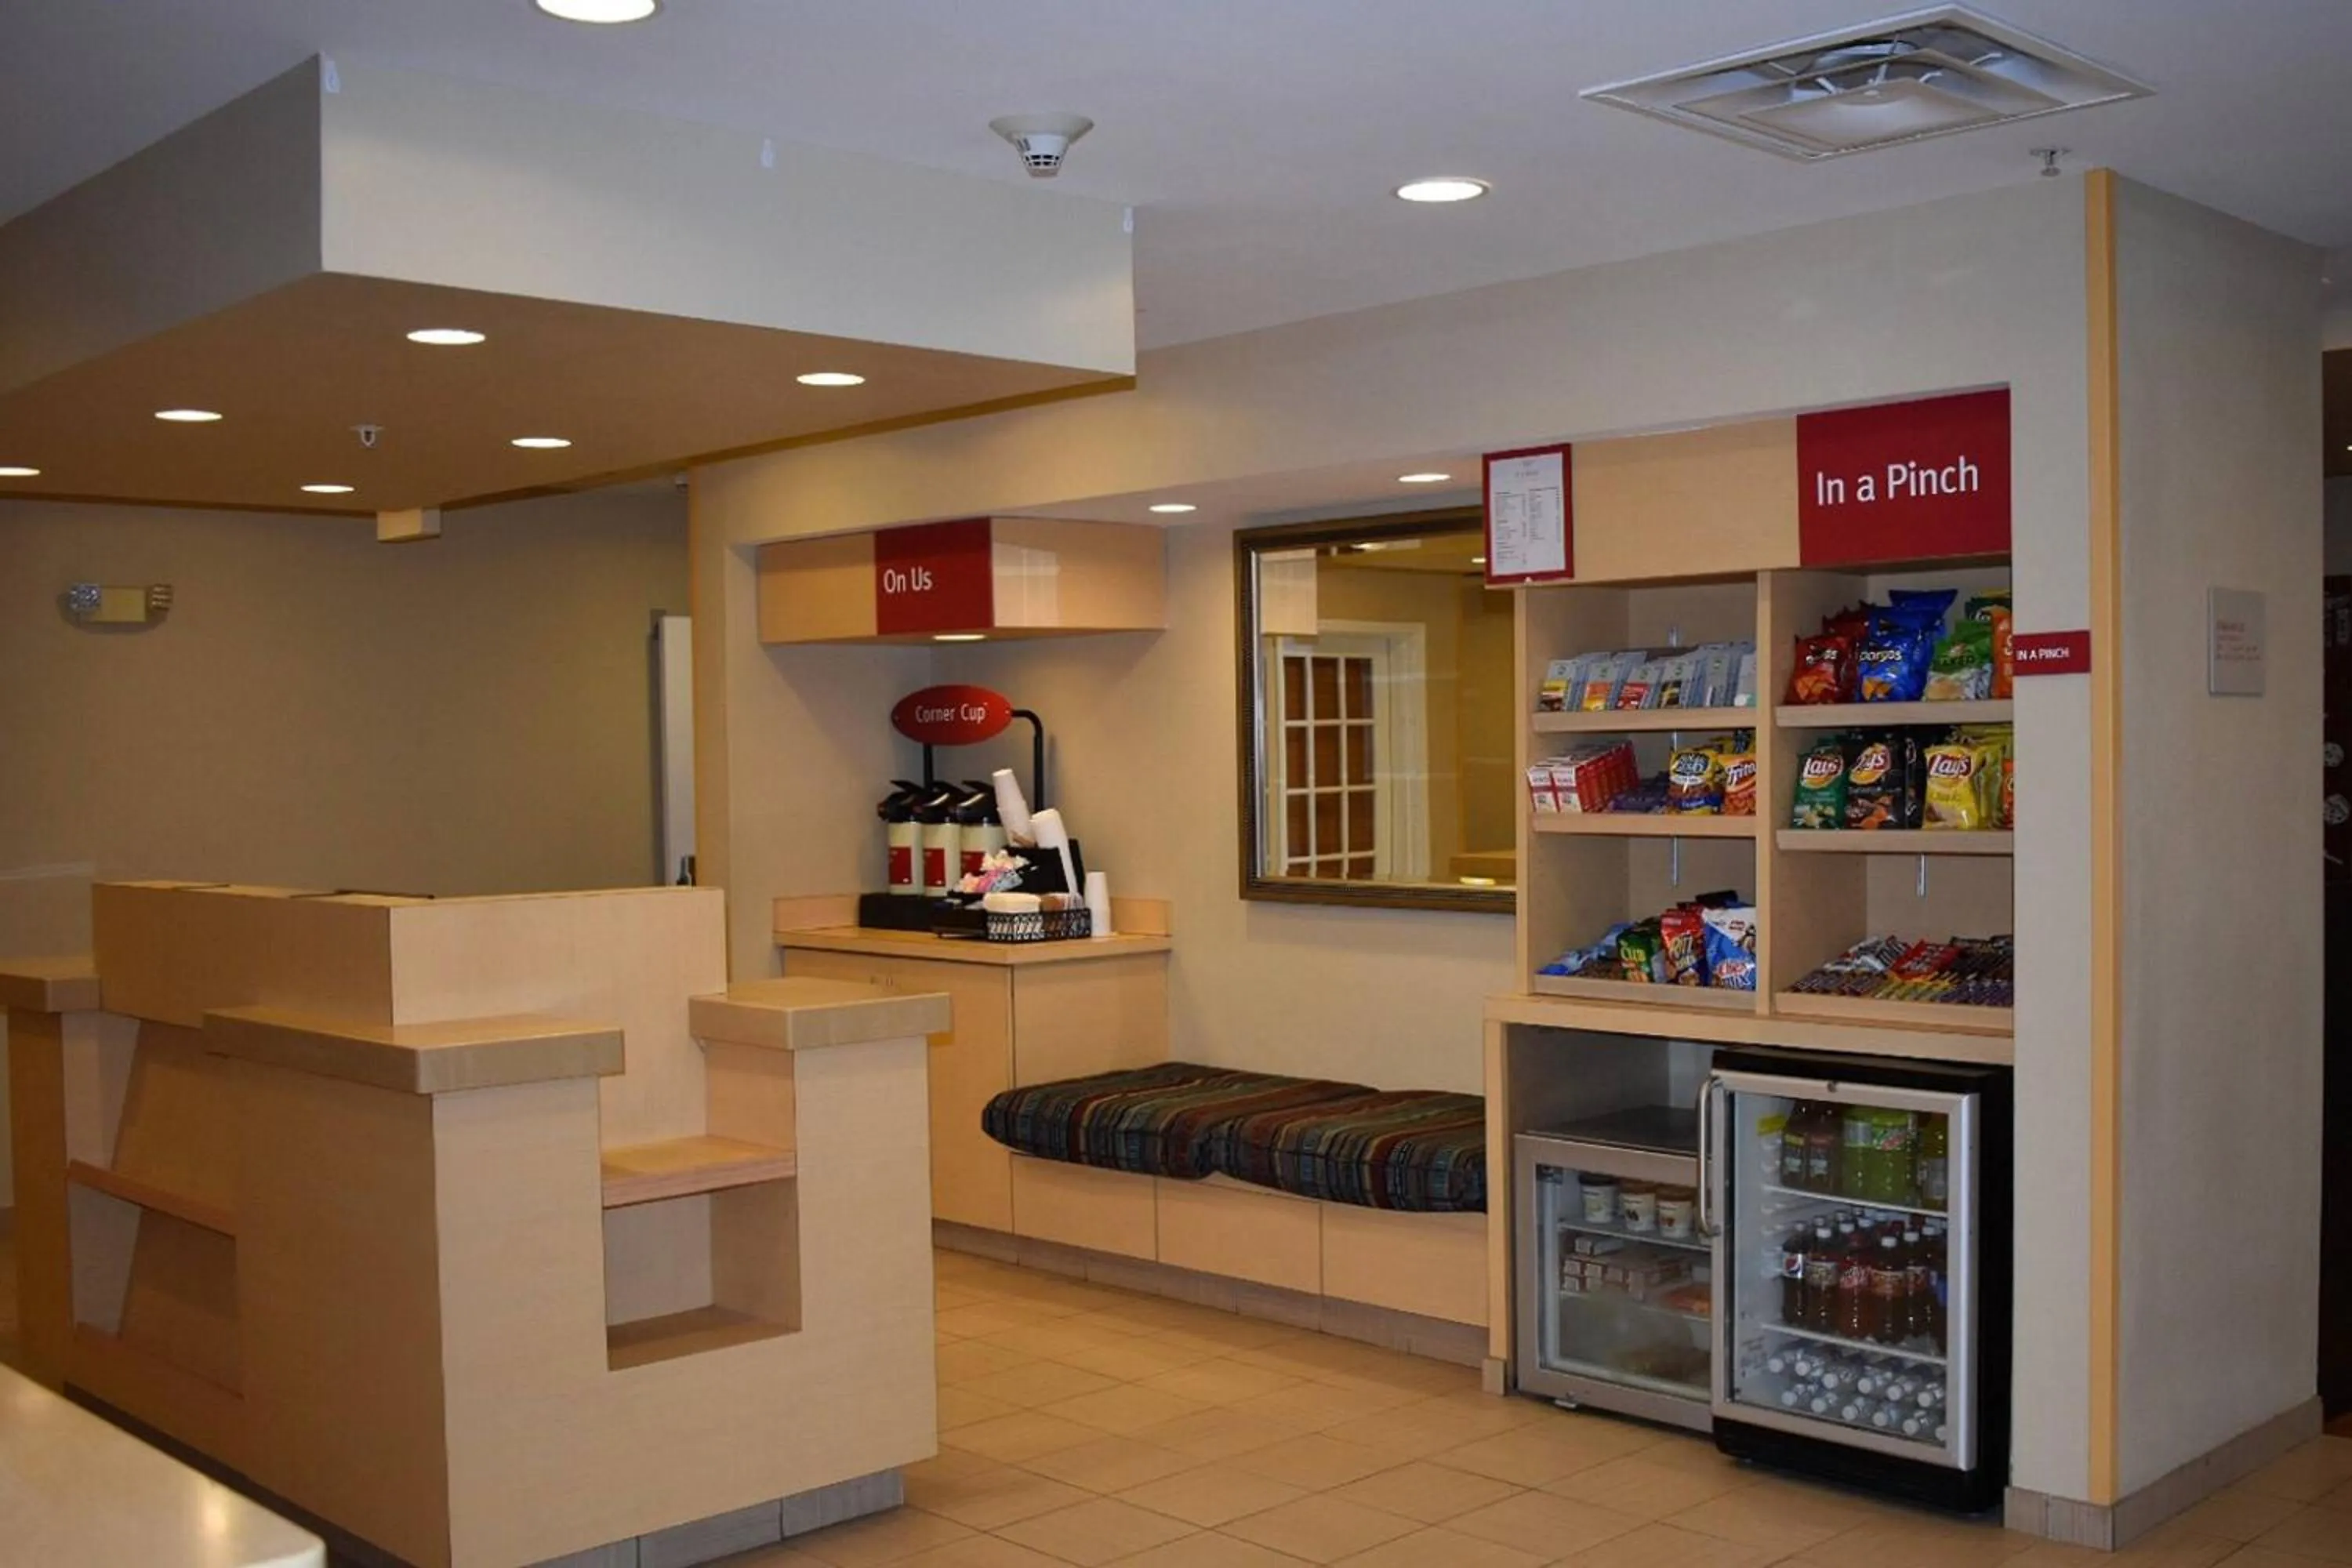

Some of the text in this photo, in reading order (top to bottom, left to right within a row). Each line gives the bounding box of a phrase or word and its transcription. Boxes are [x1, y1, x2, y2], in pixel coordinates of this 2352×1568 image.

[1817, 455, 1979, 506] In a Pinch
[883, 565, 932, 593] On Us
[2016, 647, 2069, 661] IN A PINCH
[915, 706, 955, 723] Corner
[1726, 764, 1756, 786] Frito
